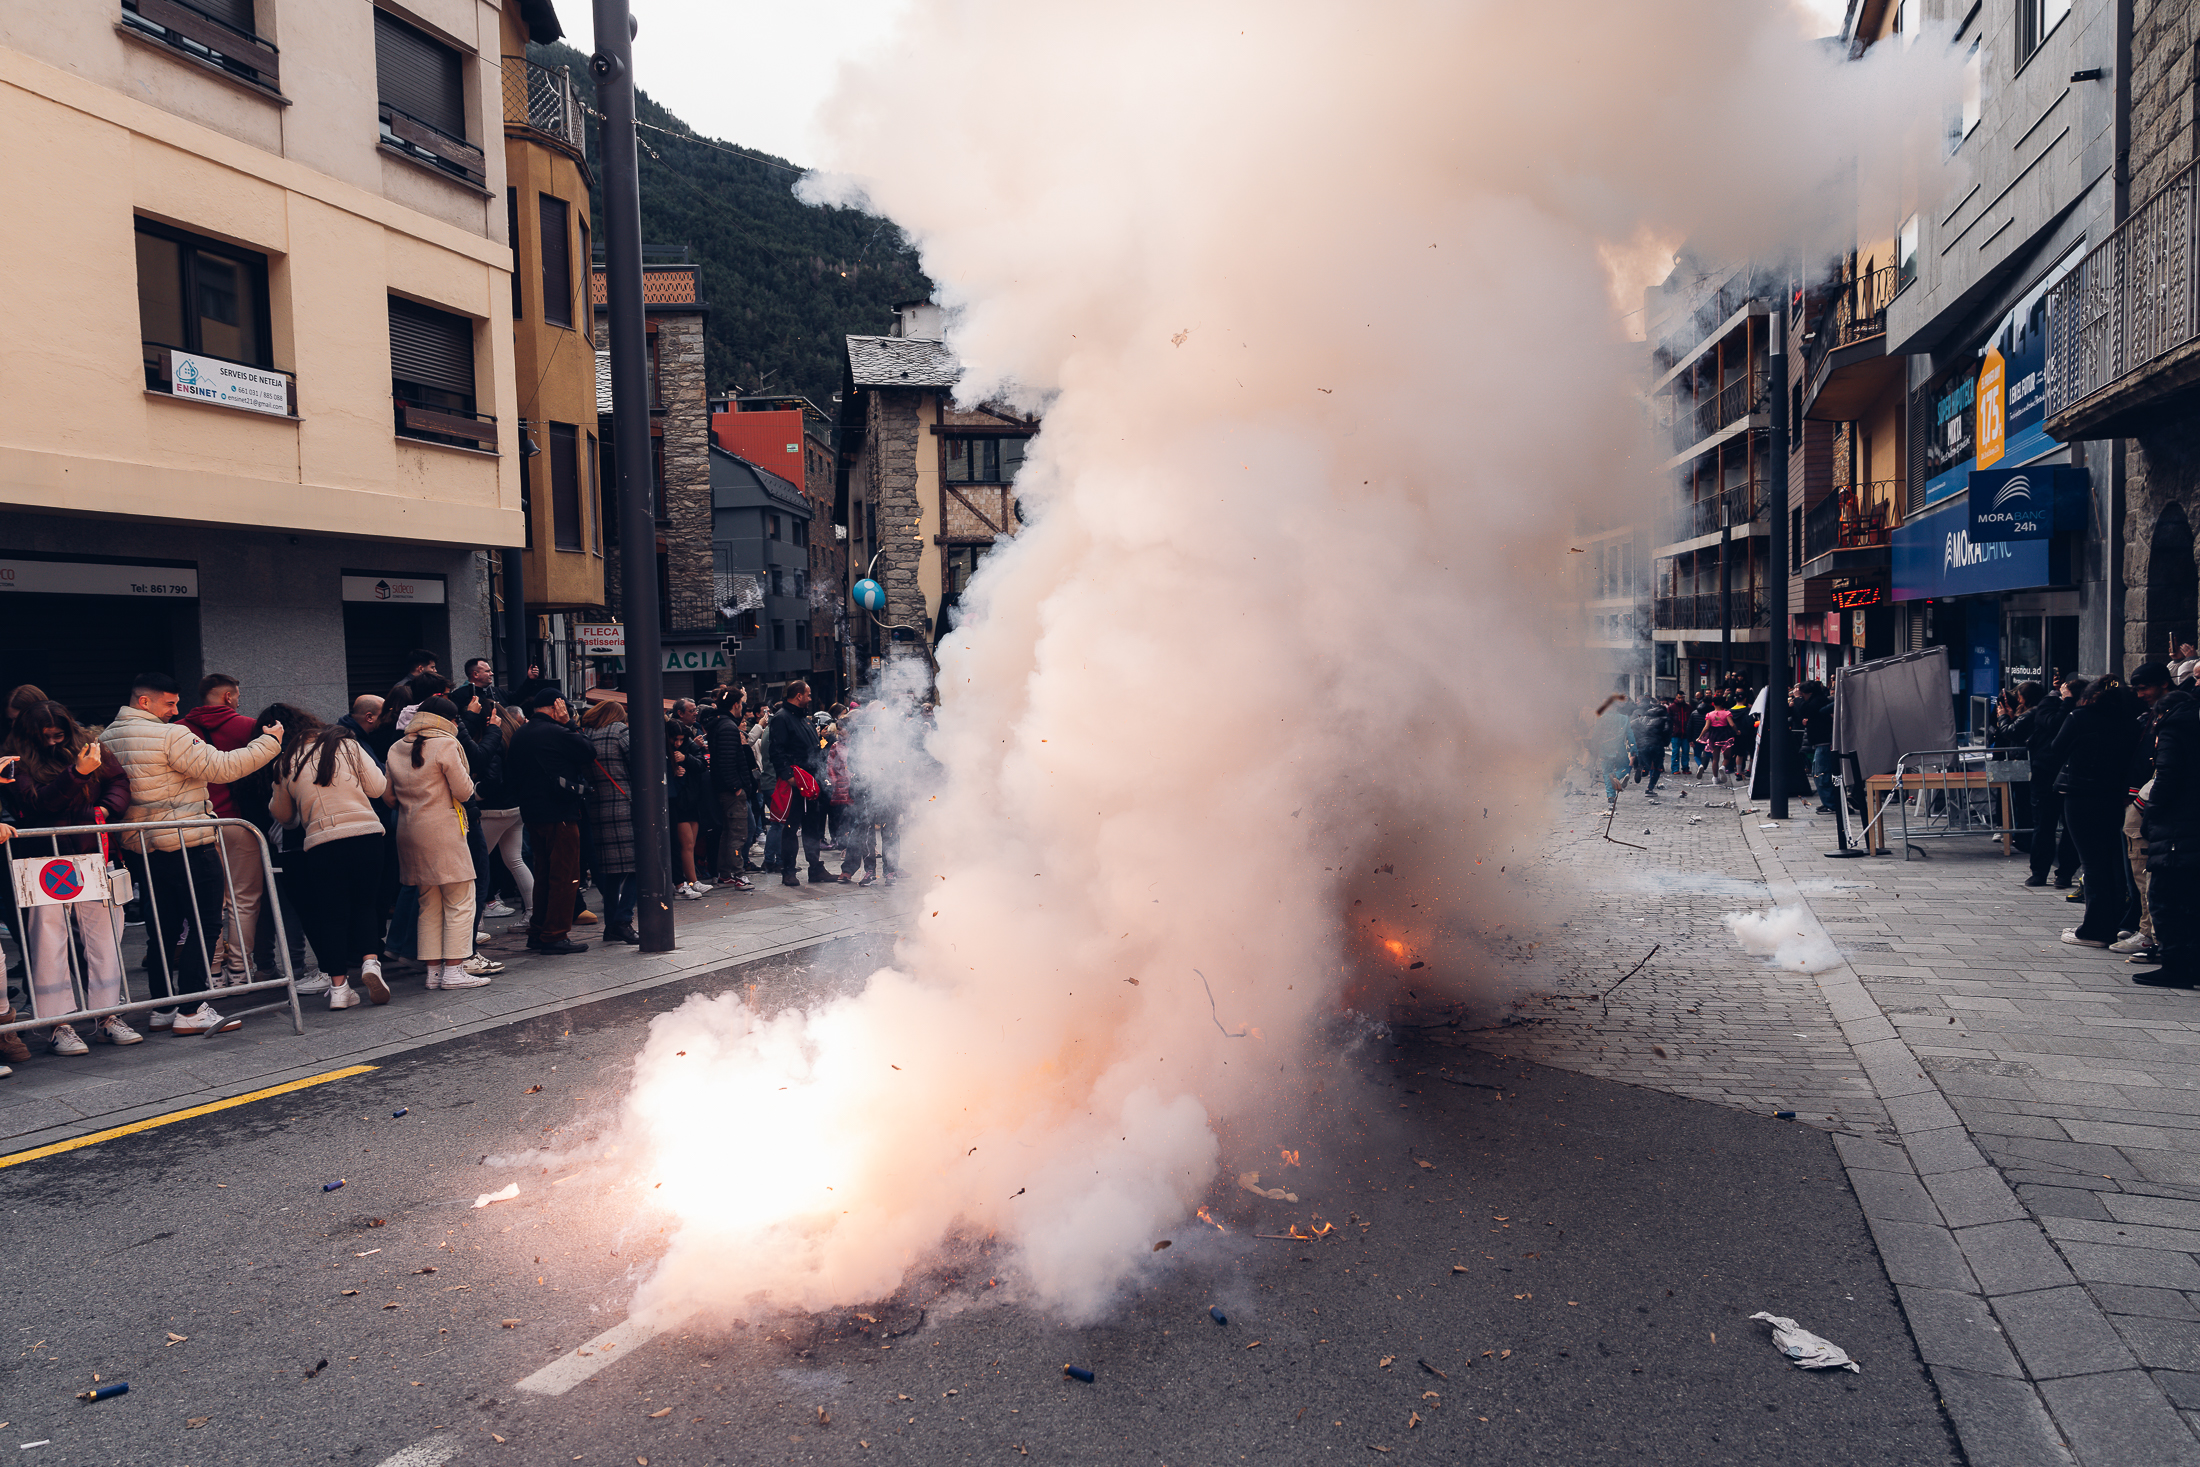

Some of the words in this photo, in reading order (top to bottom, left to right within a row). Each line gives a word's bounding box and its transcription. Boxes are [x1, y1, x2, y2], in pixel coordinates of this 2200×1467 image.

[220, 367, 248, 380] SERVEIS
[248, 373, 257, 382] DE
[259, 376, 283, 388] NETEJA
[176, 383, 217, 398] ENSINET
[238, 387, 248, 395] 661
[227, 394, 284, 411] ensinet21@gmail.com
[1978, 509, 2046, 523] MORABANC
[2014, 521, 2037, 532] 24h
[130, 584, 148, 593] Tel:
[150, 585, 167, 593] 861
[169, 585, 188, 594] 790
[392, 582, 414, 594] sideco
[583, 627, 619, 636] FLECA
[577, 637, 625, 646] Pastisseria
